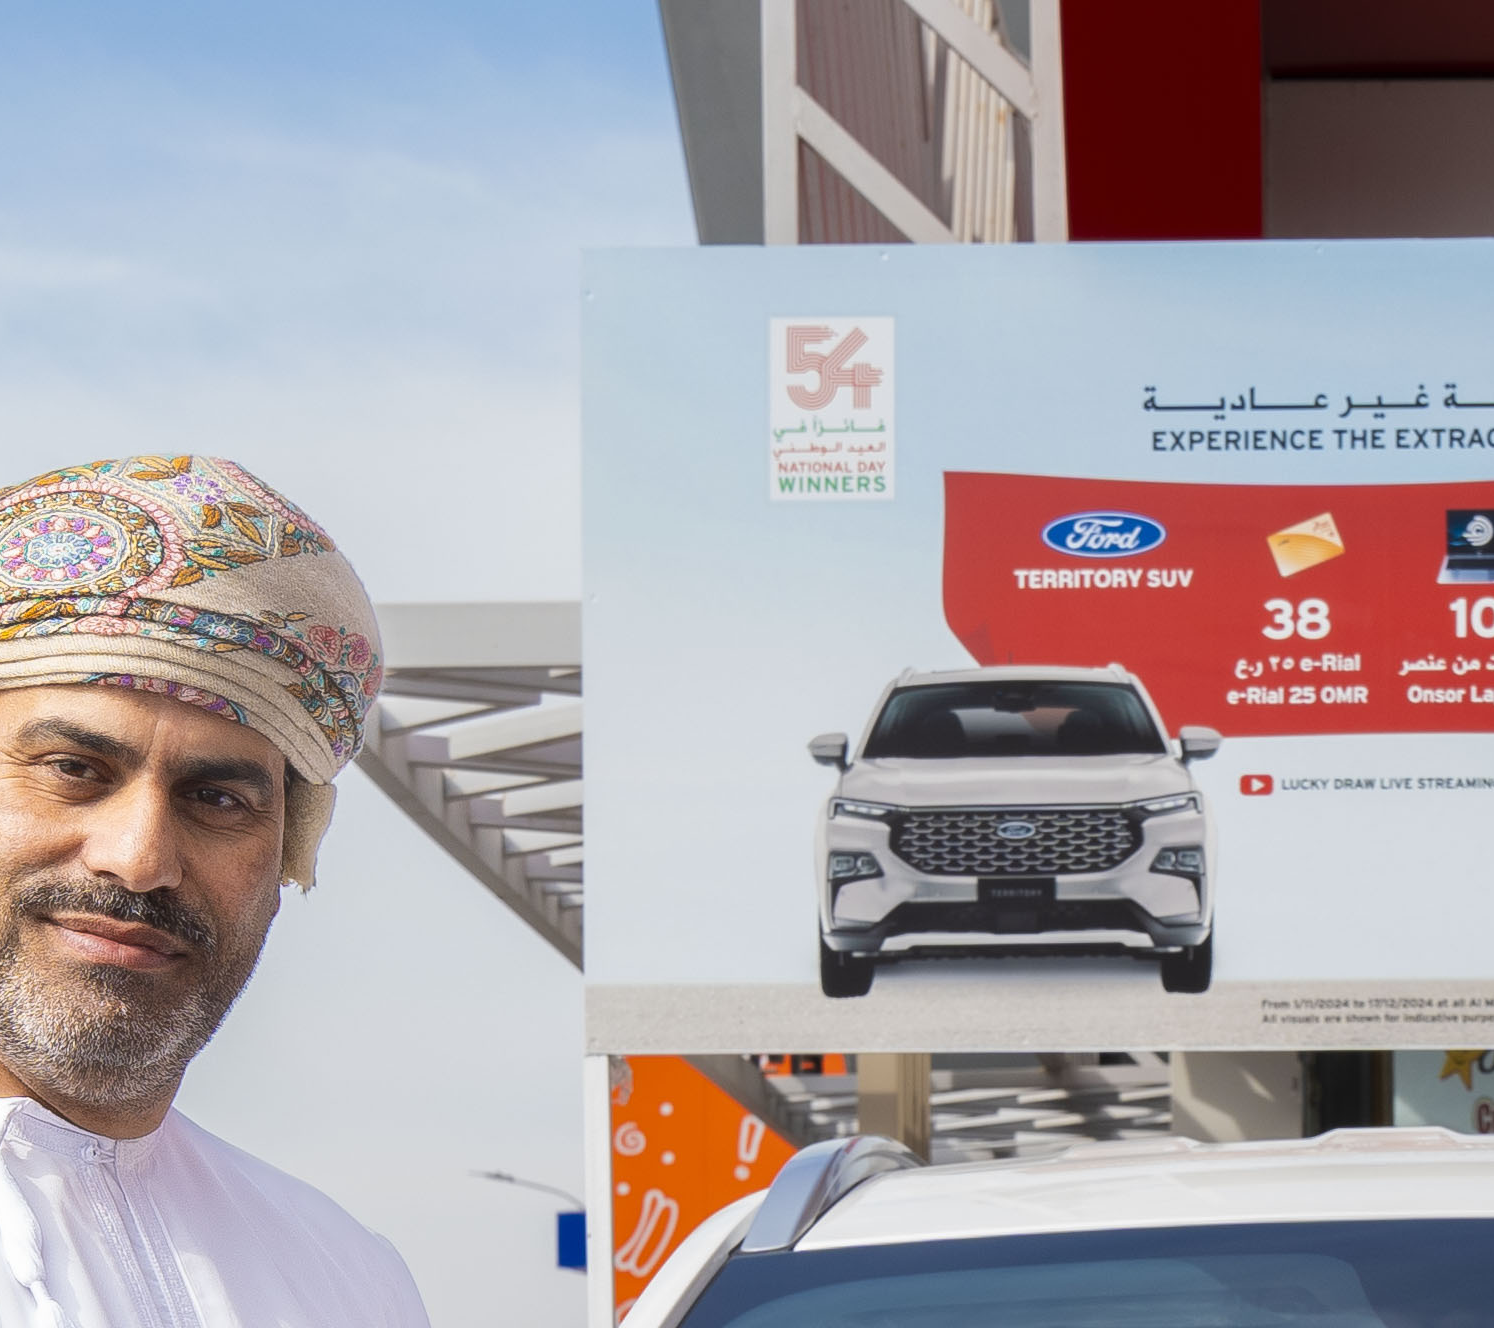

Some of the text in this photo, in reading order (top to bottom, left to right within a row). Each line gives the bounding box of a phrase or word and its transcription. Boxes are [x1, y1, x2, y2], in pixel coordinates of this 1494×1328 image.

[786, 325, 884, 411] 54
[1143, 386, 1328, 420] عادية
[1338, 384, 1429, 418] غير
[1152, 429, 1323, 451] EXPERIENCE
[1333, 428, 1385, 450] THE
[778, 461, 886, 473] NATIONAL DAY
[778, 476, 886, 493] WINNERS
[1065, 517, 1143, 550] Ford
[1014, 569, 1194, 589] TERRITORY SUV
[1262, 598, 1331, 640] 38
[1300, 653, 1361, 672] e-Rial
[1398, 654, 1447, 676] عنصر
[1452, 654, 1481, 676] من
[1226, 686, 1369, 705] e-Rial 25 OMR
[1407, 685, 1466, 703] Onsor
[1281, 778, 1329, 791] LUCKY
[1333, 778, 1376, 790] DRAW
[1380, 778, 1412, 790] LIVE
